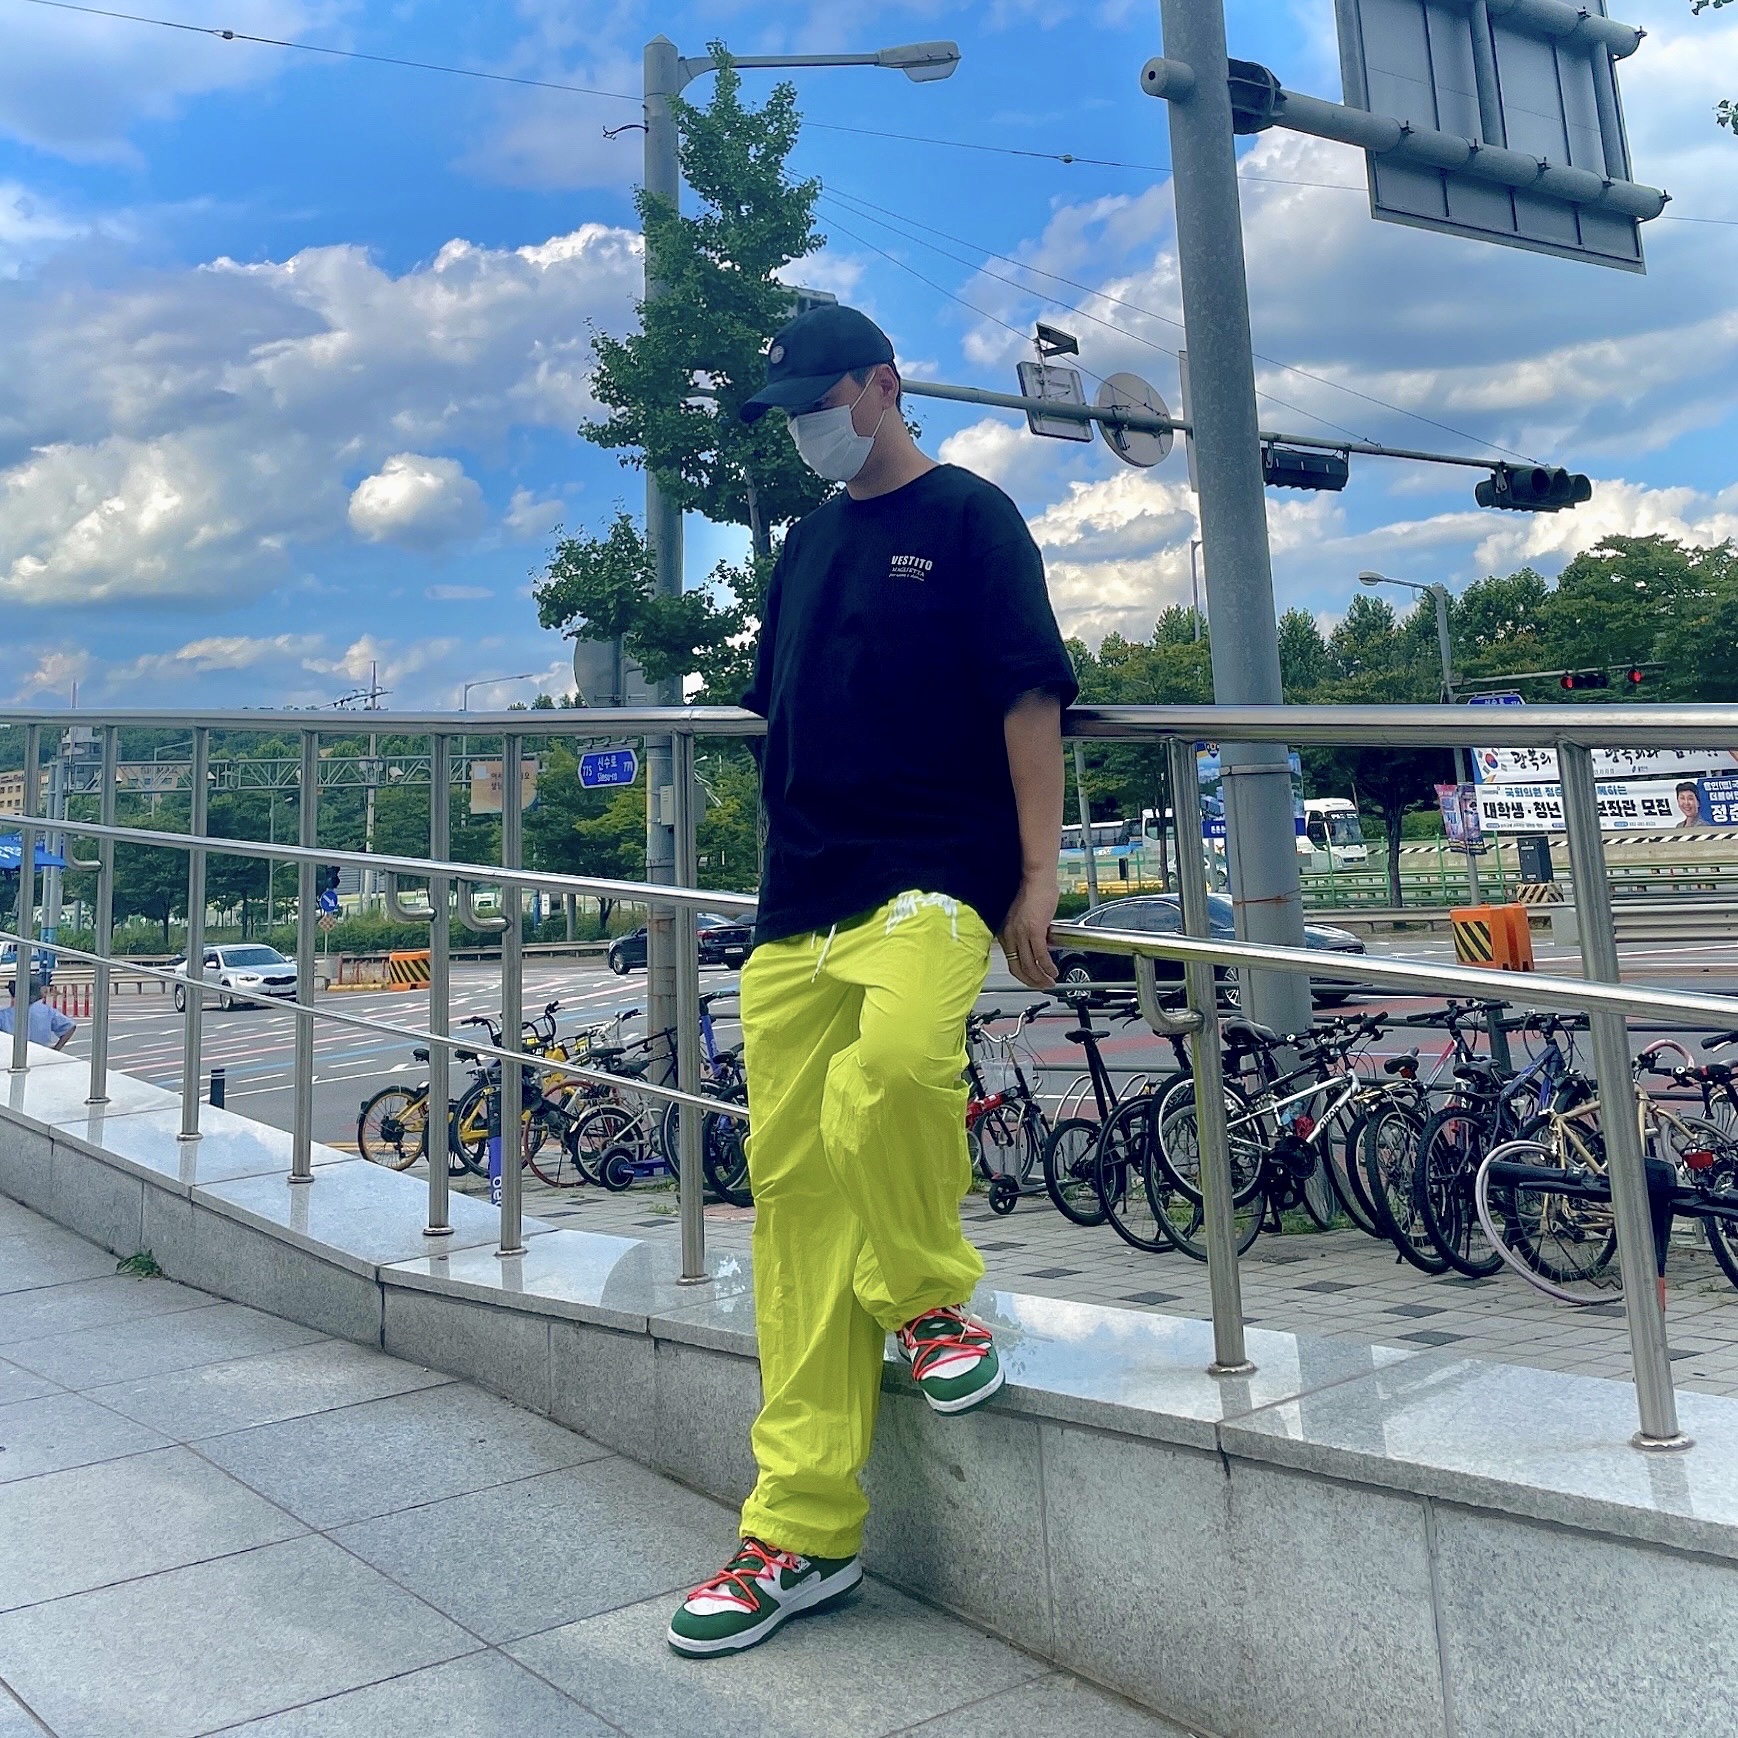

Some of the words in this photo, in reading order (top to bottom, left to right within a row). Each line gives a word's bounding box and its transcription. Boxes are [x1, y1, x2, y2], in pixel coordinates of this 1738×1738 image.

[891, 555, 933, 571] VESTITO
[583, 765, 593, 776] 775
[597, 755, 617, 771] 신수로
[1505, 787, 1543, 797] 국회의원
[1641, 798, 1673, 816] 모집
[1320, 1105, 1341, 1129] alton
